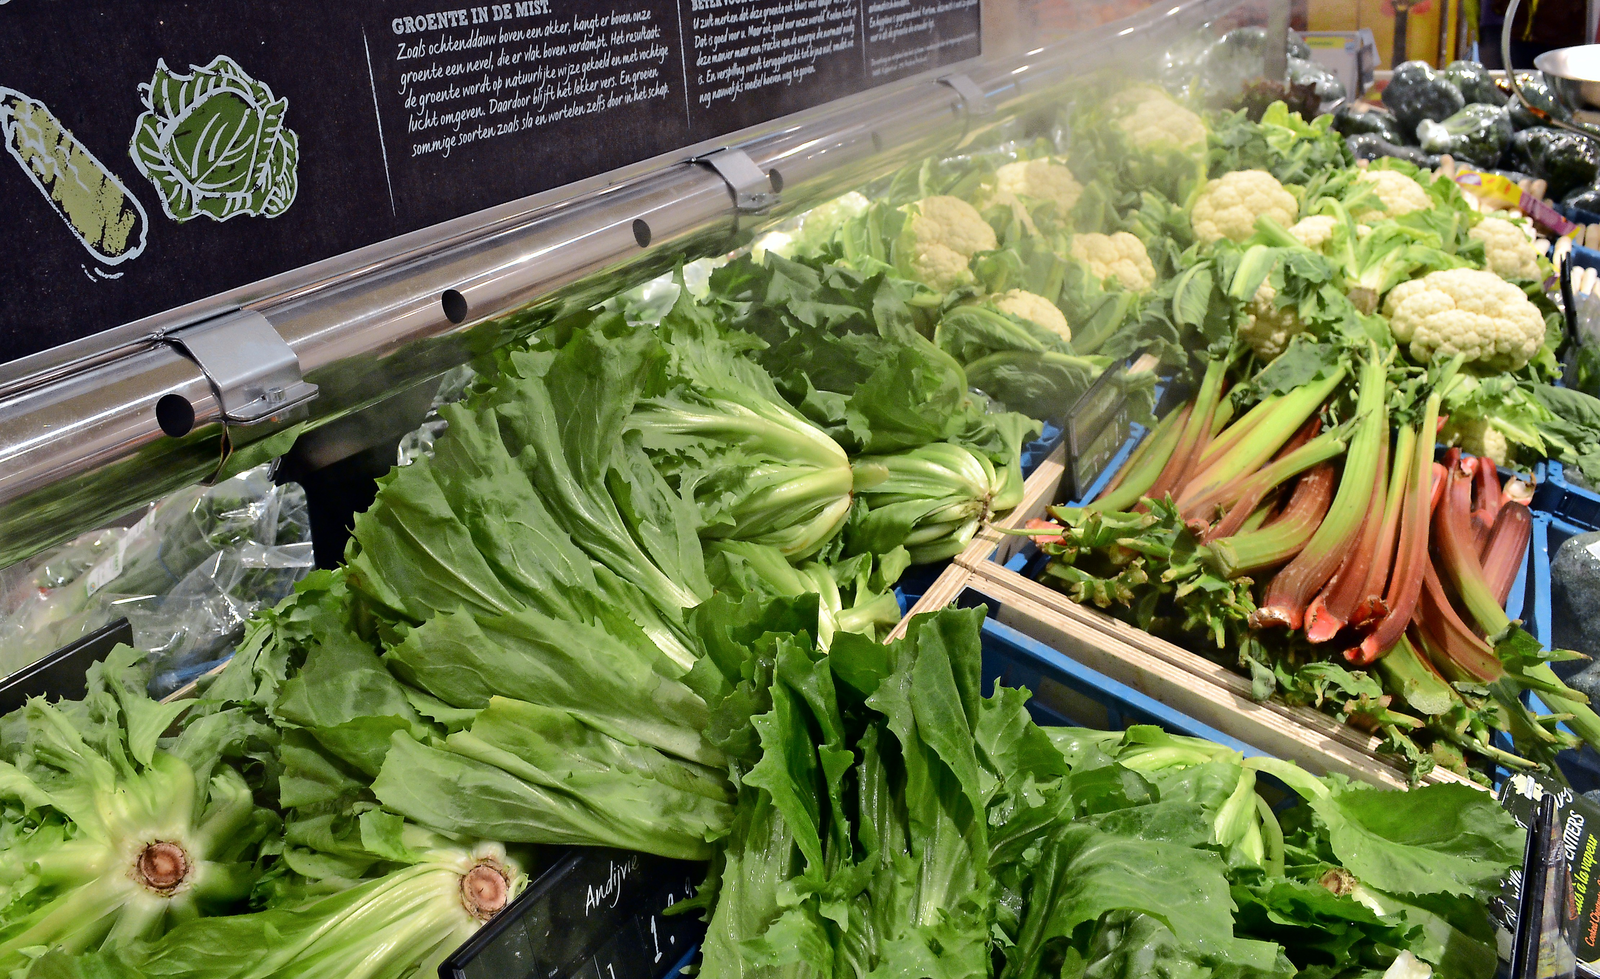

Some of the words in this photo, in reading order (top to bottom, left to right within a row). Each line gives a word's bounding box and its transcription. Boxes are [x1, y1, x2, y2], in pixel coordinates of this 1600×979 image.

[391, 9, 469, 35] GROENTE
[470, 6, 488, 24] IN
[492, 3, 512, 21] DE
[515, 0, 552, 18] MIST.
[396, 38, 426, 60] Zoals
[428, 28, 496, 55] ochtenddauw
[498, 26, 525, 44] boven
[526, 27, 543, 39] een
[544, 19, 571, 35] akker,
[573, 14, 599, 37] hangt
[600, 15, 610, 26] er
[610, 10, 632, 25] boven
[633, 9, 651, 21] onze
[693, 17, 699, 30] U
[739, 6, 749, 21] dat
[750, 4, 762, 19] deze
[694, 33, 707, 48] Dat
[712, 27, 728, 52] goed
[748, 25, 762, 37] Maar
[696, 50, 711, 66] deze
[734, 46, 750, 58] maar
[398, 62, 443, 95] groente
[445, 63, 465, 77] een
[466, 51, 494, 74] nevel,
[497, 47, 510, 67] die
[512, 51, 523, 64] er
[524, 44, 541, 62] vlak
[543, 42, 567, 58] boven
[568, 34, 608, 55] verdampt.
[610, 30, 625, 46] Het
[625, 24, 661, 43] resultaat:
[706, 69, 716, 83] En
[404, 87, 417, 109] de
[417, 83, 460, 115] groente
[462, 73, 491, 97] wordt
[492, 75, 502, 96] op
[505, 65, 556, 90] natuurlijke
[557, 63, 580, 85] wijze
[580, 50, 611, 80] gekoeld
[611, 57, 622, 66] en
[622, 48, 639, 63] met
[639, 42, 669, 64] vochtige
[408, 109, 439, 134] lucht
[440, 106, 486, 132] omgeven.
[488, 90, 531, 115] Daardoor
[532, 85, 556, 112] blijft
[557, 81, 572, 99] het
[573, 78, 599, 96] lekker
[600, 75, 617, 89] vers.
[620, 70, 631, 85] En
[631, 67, 659, 90] groeien
[699, 91, 711, 108] nog
[411, 135, 456, 158] sommige
[458, 124, 496, 146] soorten
[497, 115, 519, 135] zoals
[521, 112, 533, 130] sla
[535, 114, 547, 126] en
[548, 101, 585, 123] wortelen
[586, 94, 605, 113] zelfs
[606, 91, 623, 108] door
[624, 92, 634, 103] in
[633, 86, 647, 101] het
[647, 80, 670, 99] schap.
[1581, 833, 1598, 872] vapeur
[586, 855, 639, 916] Andijvie
[1572, 882, 1587, 894] à
[1574, 870, 1589, 885] la
